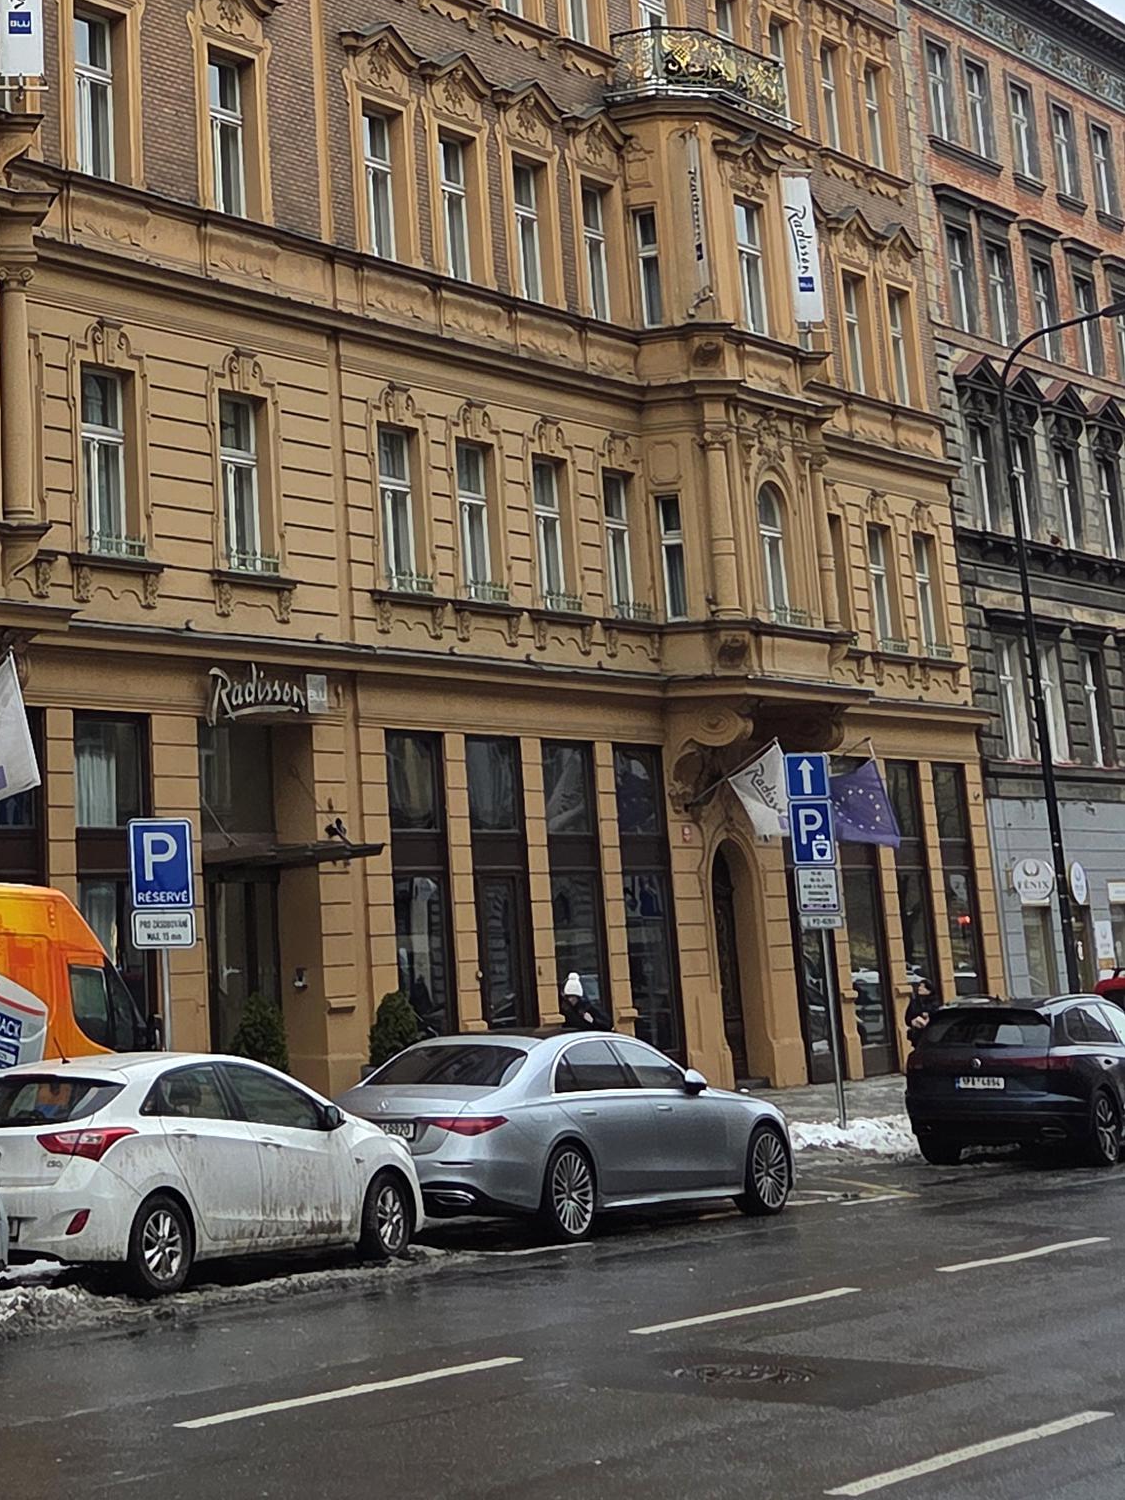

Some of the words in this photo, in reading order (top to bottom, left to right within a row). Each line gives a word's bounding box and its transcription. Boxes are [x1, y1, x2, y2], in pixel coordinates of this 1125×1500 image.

[784, 205, 813, 275] Radisson
[208, 662, 306, 727] Radisson
[798, 808, 823, 845] P
[143, 832, 177, 881] P
[138, 890, 188, 902] RÉSERVÉ
